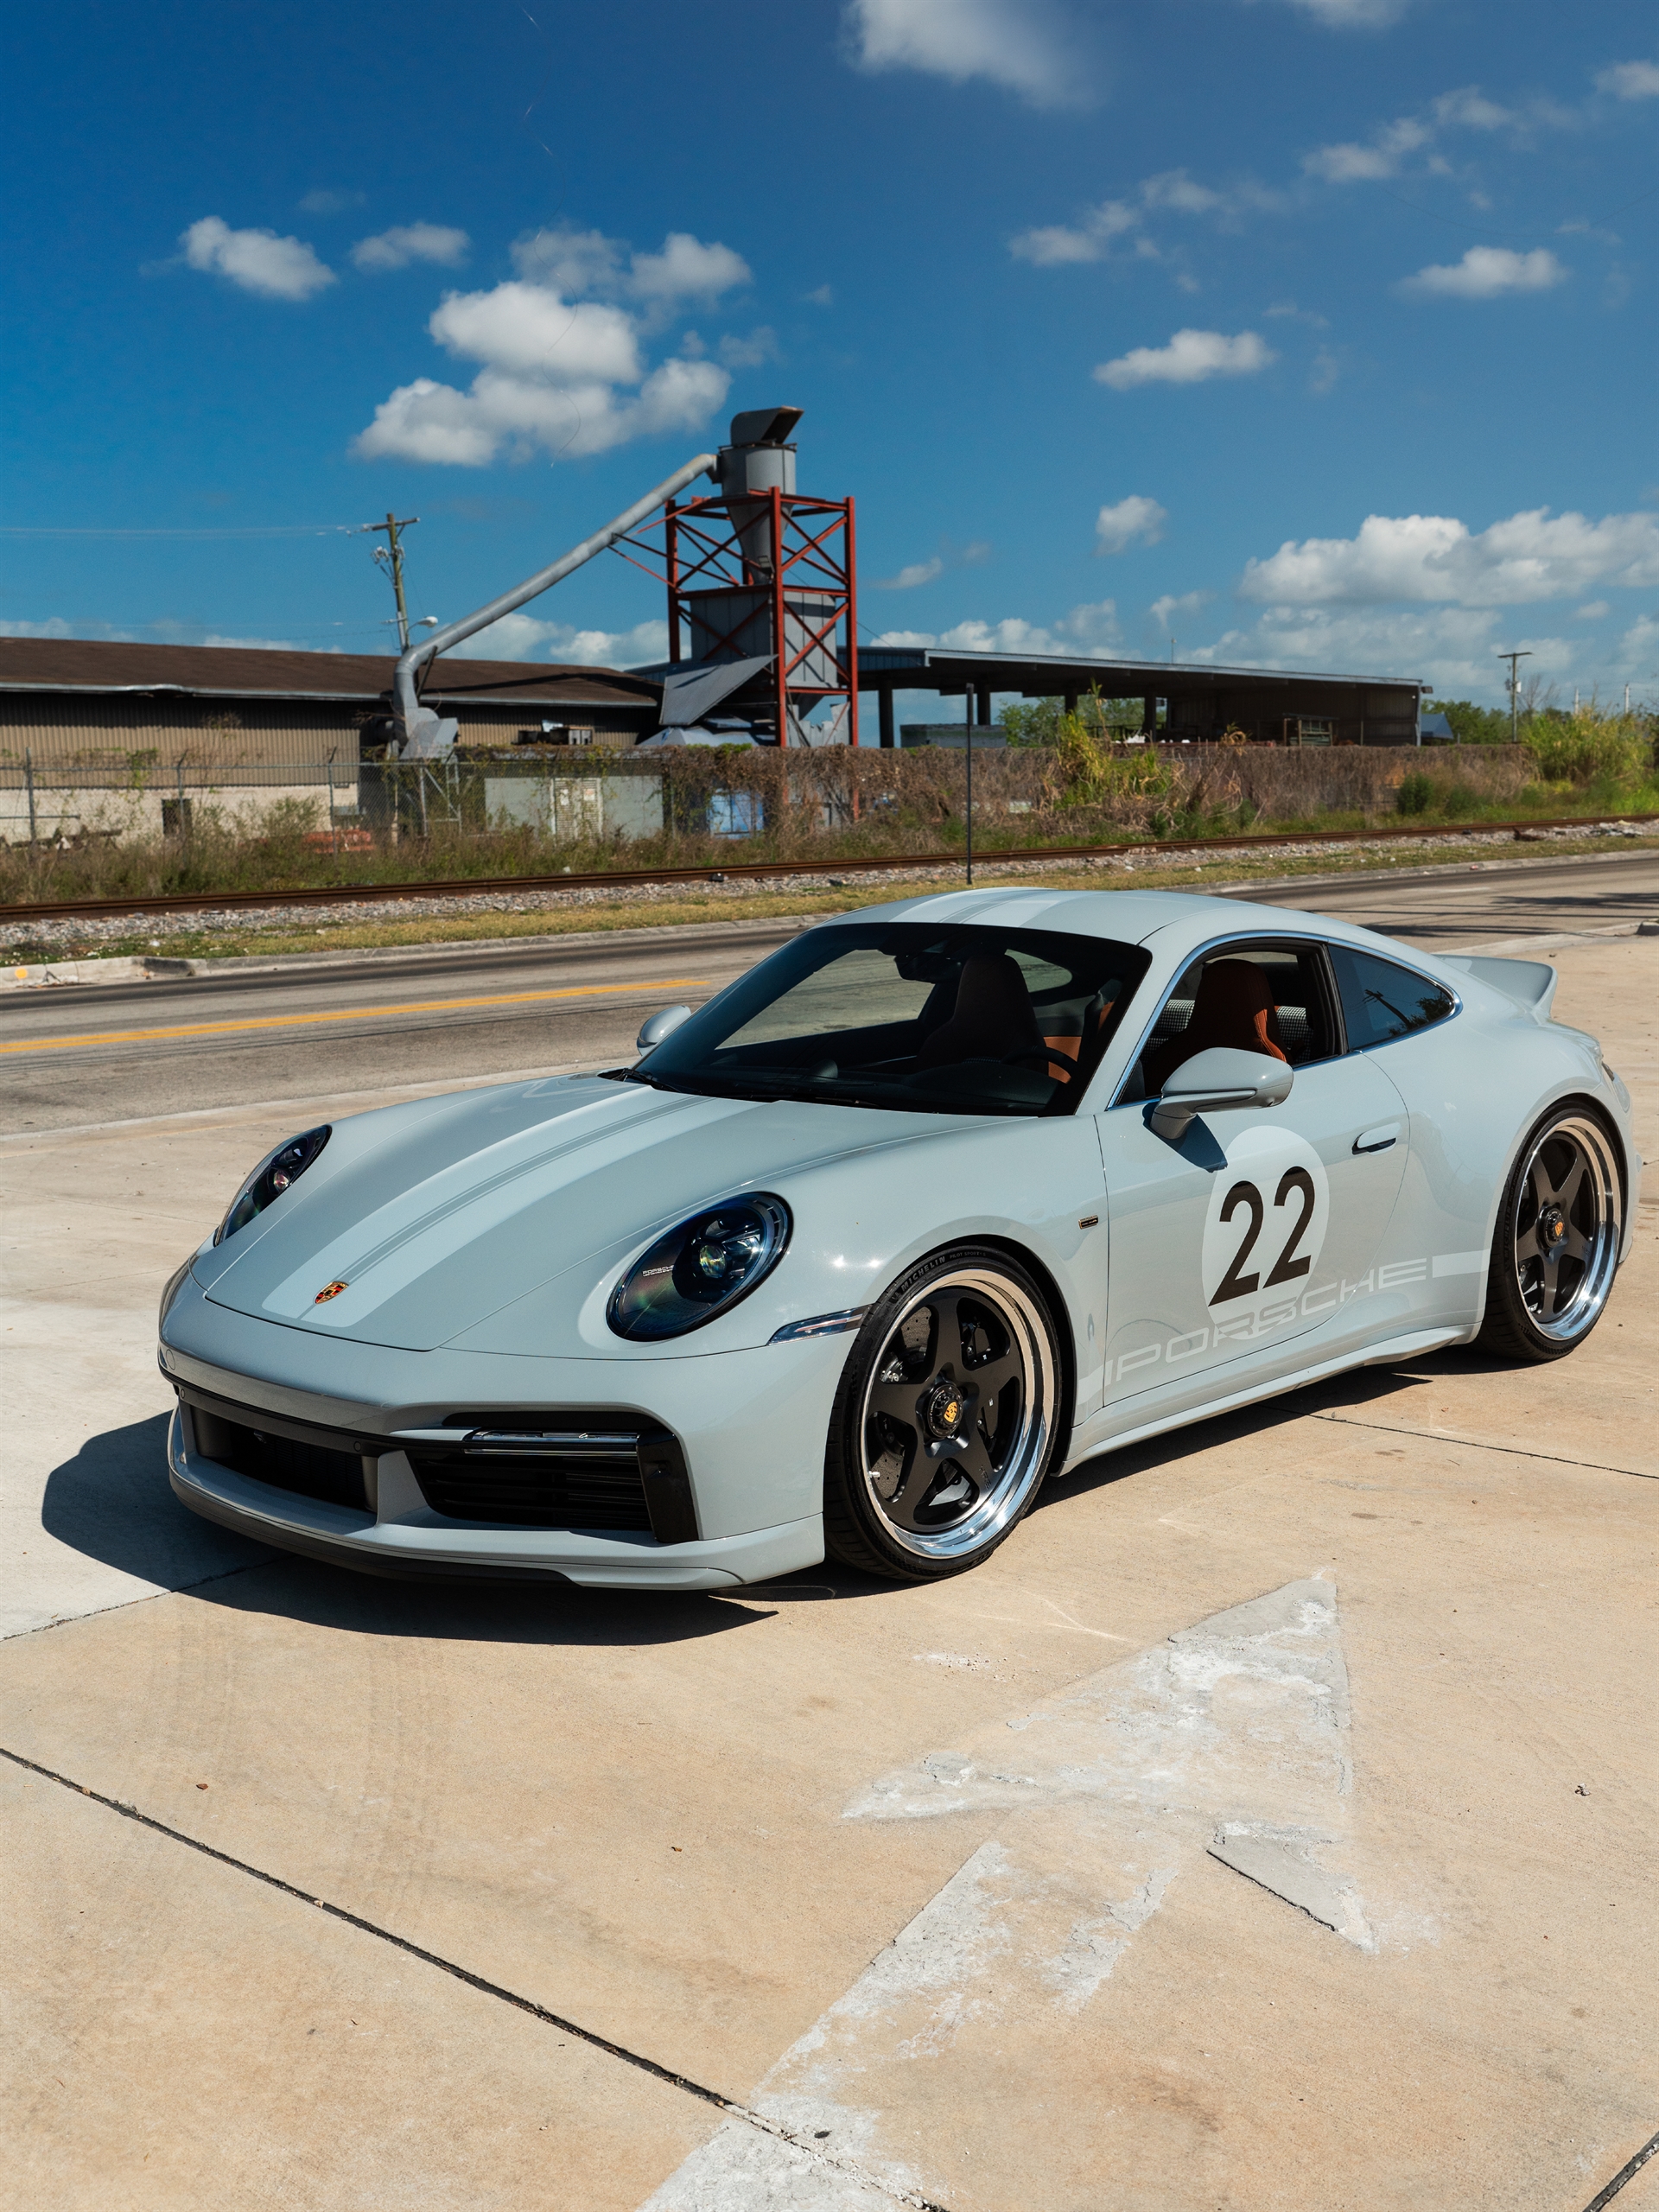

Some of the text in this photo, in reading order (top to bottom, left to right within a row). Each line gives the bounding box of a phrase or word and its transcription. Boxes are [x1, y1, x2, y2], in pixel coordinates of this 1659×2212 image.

[900, 1255, 945, 1293] MICHELIN
[1207, 1165, 1316, 1308] 22
[1116, 1257, 1427, 1382] PORSCHE
